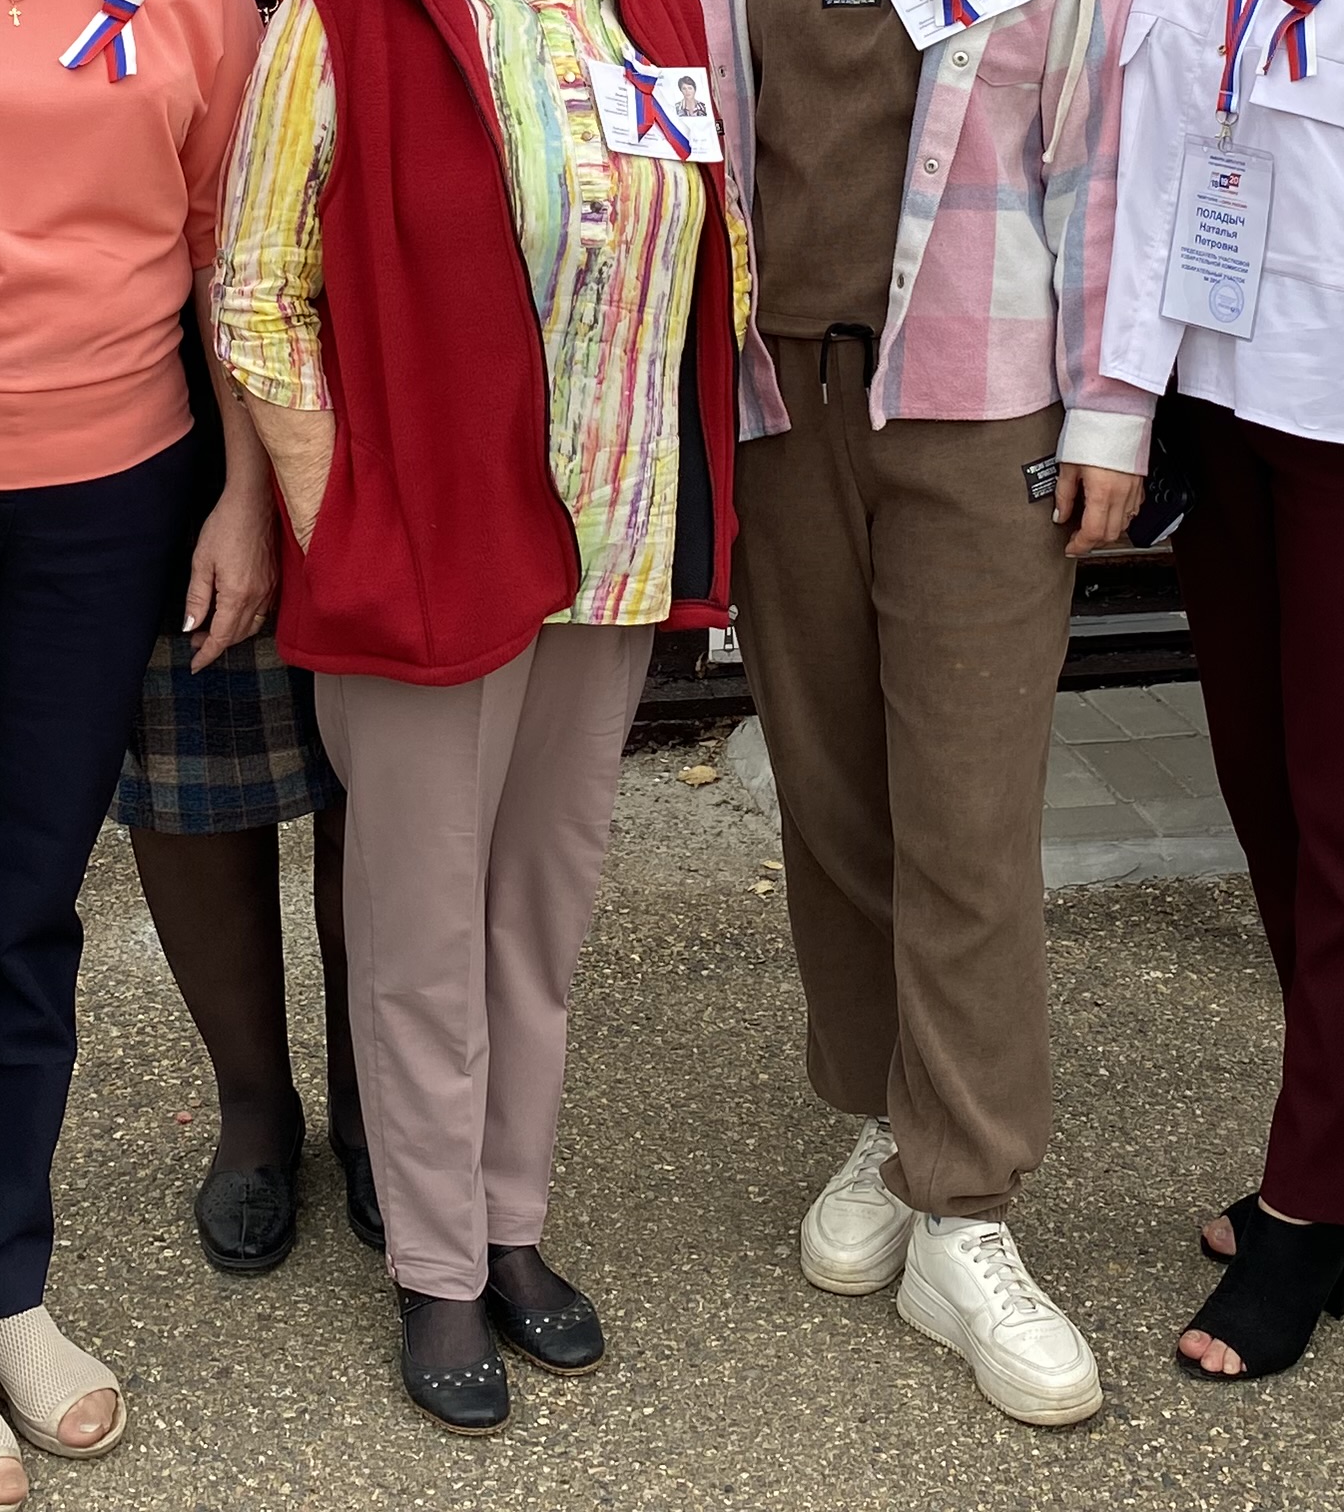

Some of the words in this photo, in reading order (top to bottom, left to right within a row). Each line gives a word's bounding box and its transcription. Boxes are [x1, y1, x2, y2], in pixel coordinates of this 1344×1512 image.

[1196, 206, 1246, 227] ПОЛАДЫЧ
[1199, 222, 1238, 239] Наталья
[1194, 234, 1239, 254] Петровна
